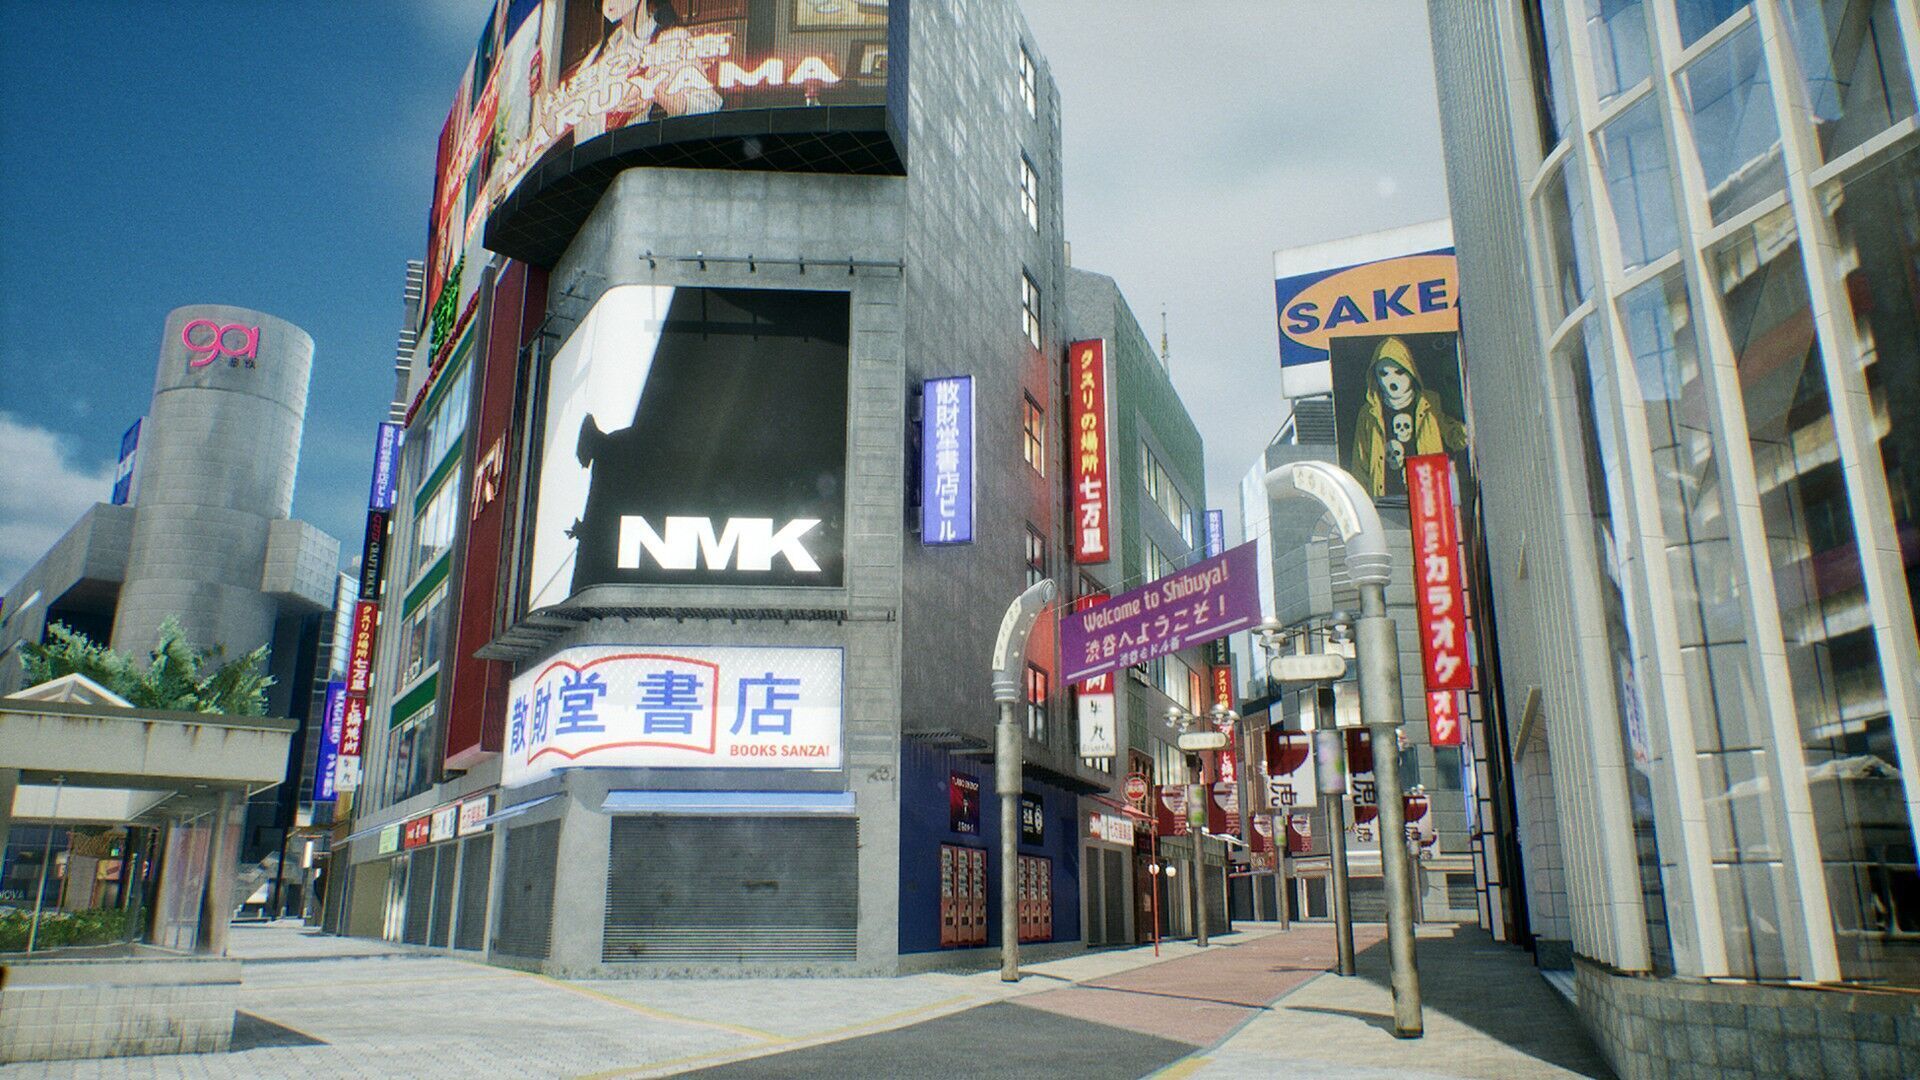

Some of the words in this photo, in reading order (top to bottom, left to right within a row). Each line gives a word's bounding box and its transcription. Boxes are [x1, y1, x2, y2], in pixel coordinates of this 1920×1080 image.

[1287, 278, 1458, 335] SAKE
[617, 515, 823, 573] NMK
[1083, 601, 1140, 633] Welcome
[1144, 591, 1160, 611] to
[1163, 560, 1229, 603] Shibuya!
[1425, 556, 1461, 684] カラオケ
[510, 670, 801, 756] 散財堂書店
[730, 744, 778, 758] BOOKS
